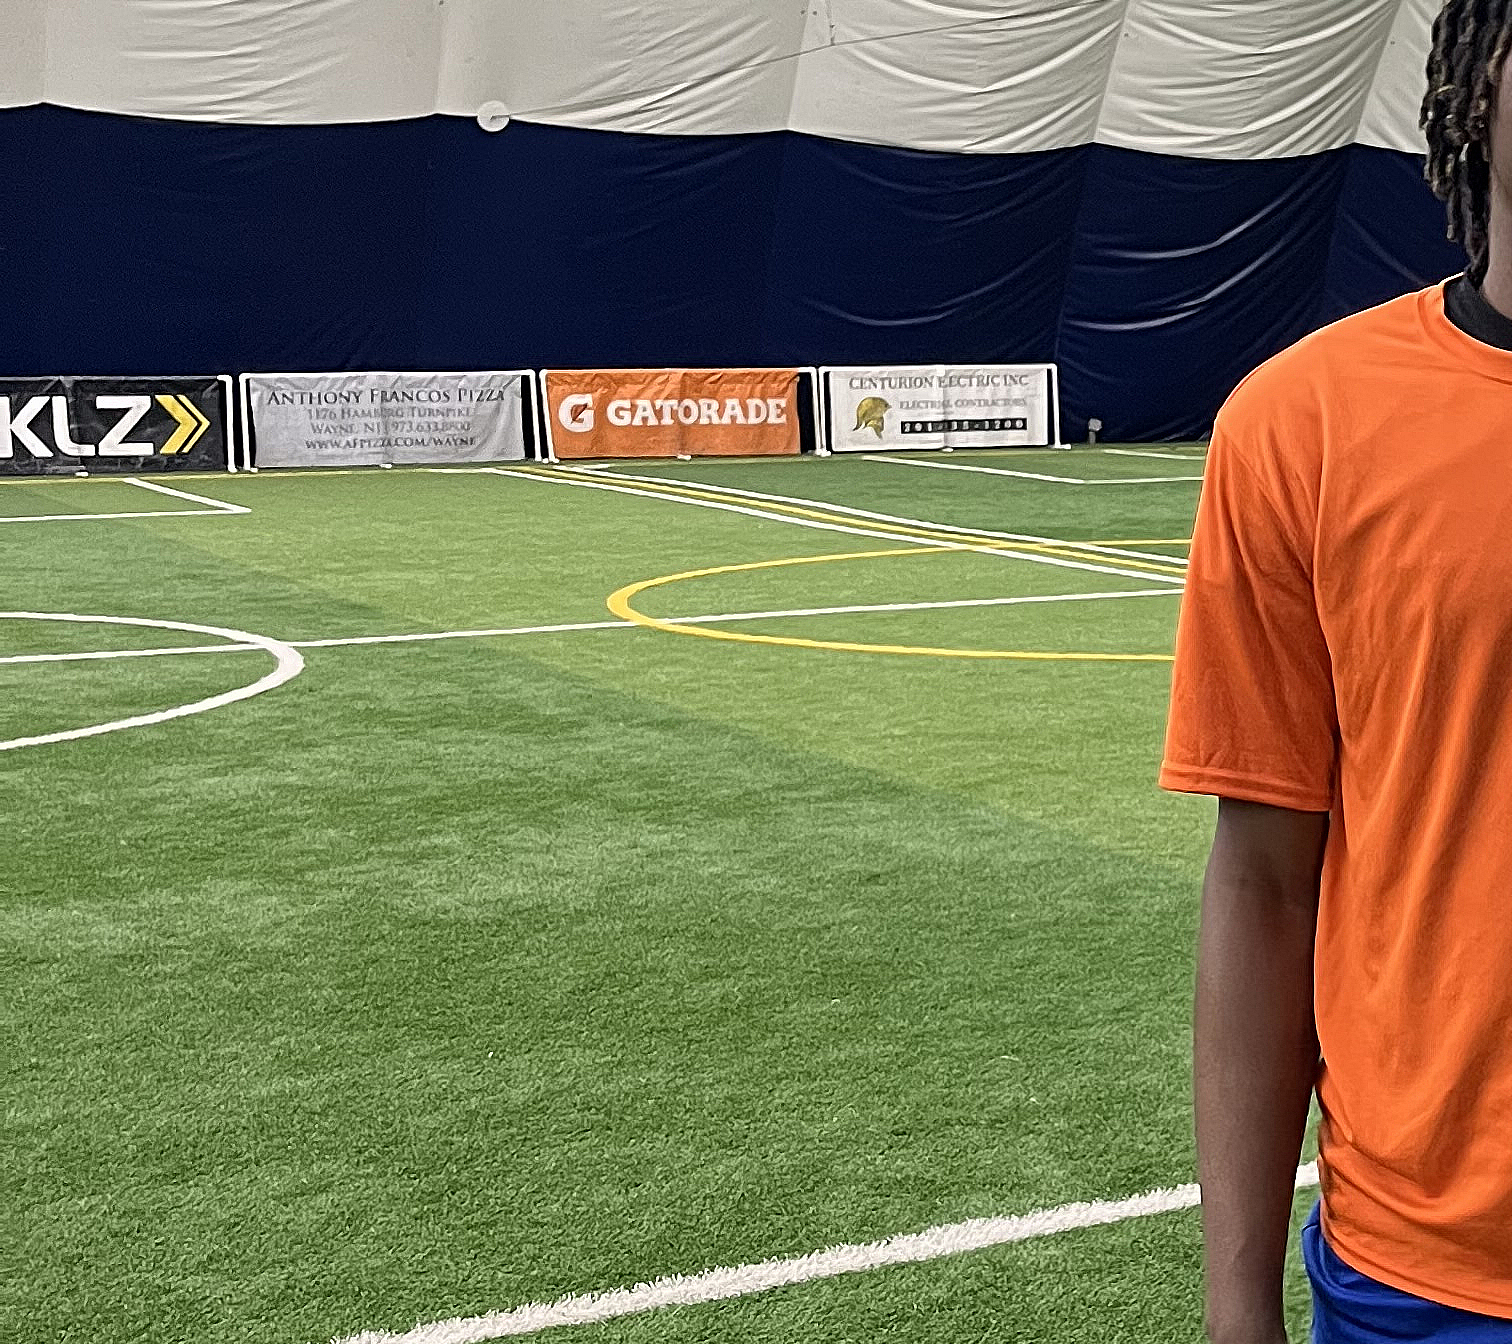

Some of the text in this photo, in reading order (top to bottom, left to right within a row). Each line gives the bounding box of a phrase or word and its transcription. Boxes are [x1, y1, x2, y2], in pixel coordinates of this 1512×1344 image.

[848, 374, 1029, 390] CENTURION ELECTRIC INC
[267, 387, 505, 405] ANTHONY FRANCOS PIZZA
[558, 393, 787, 432] G GATORADE
